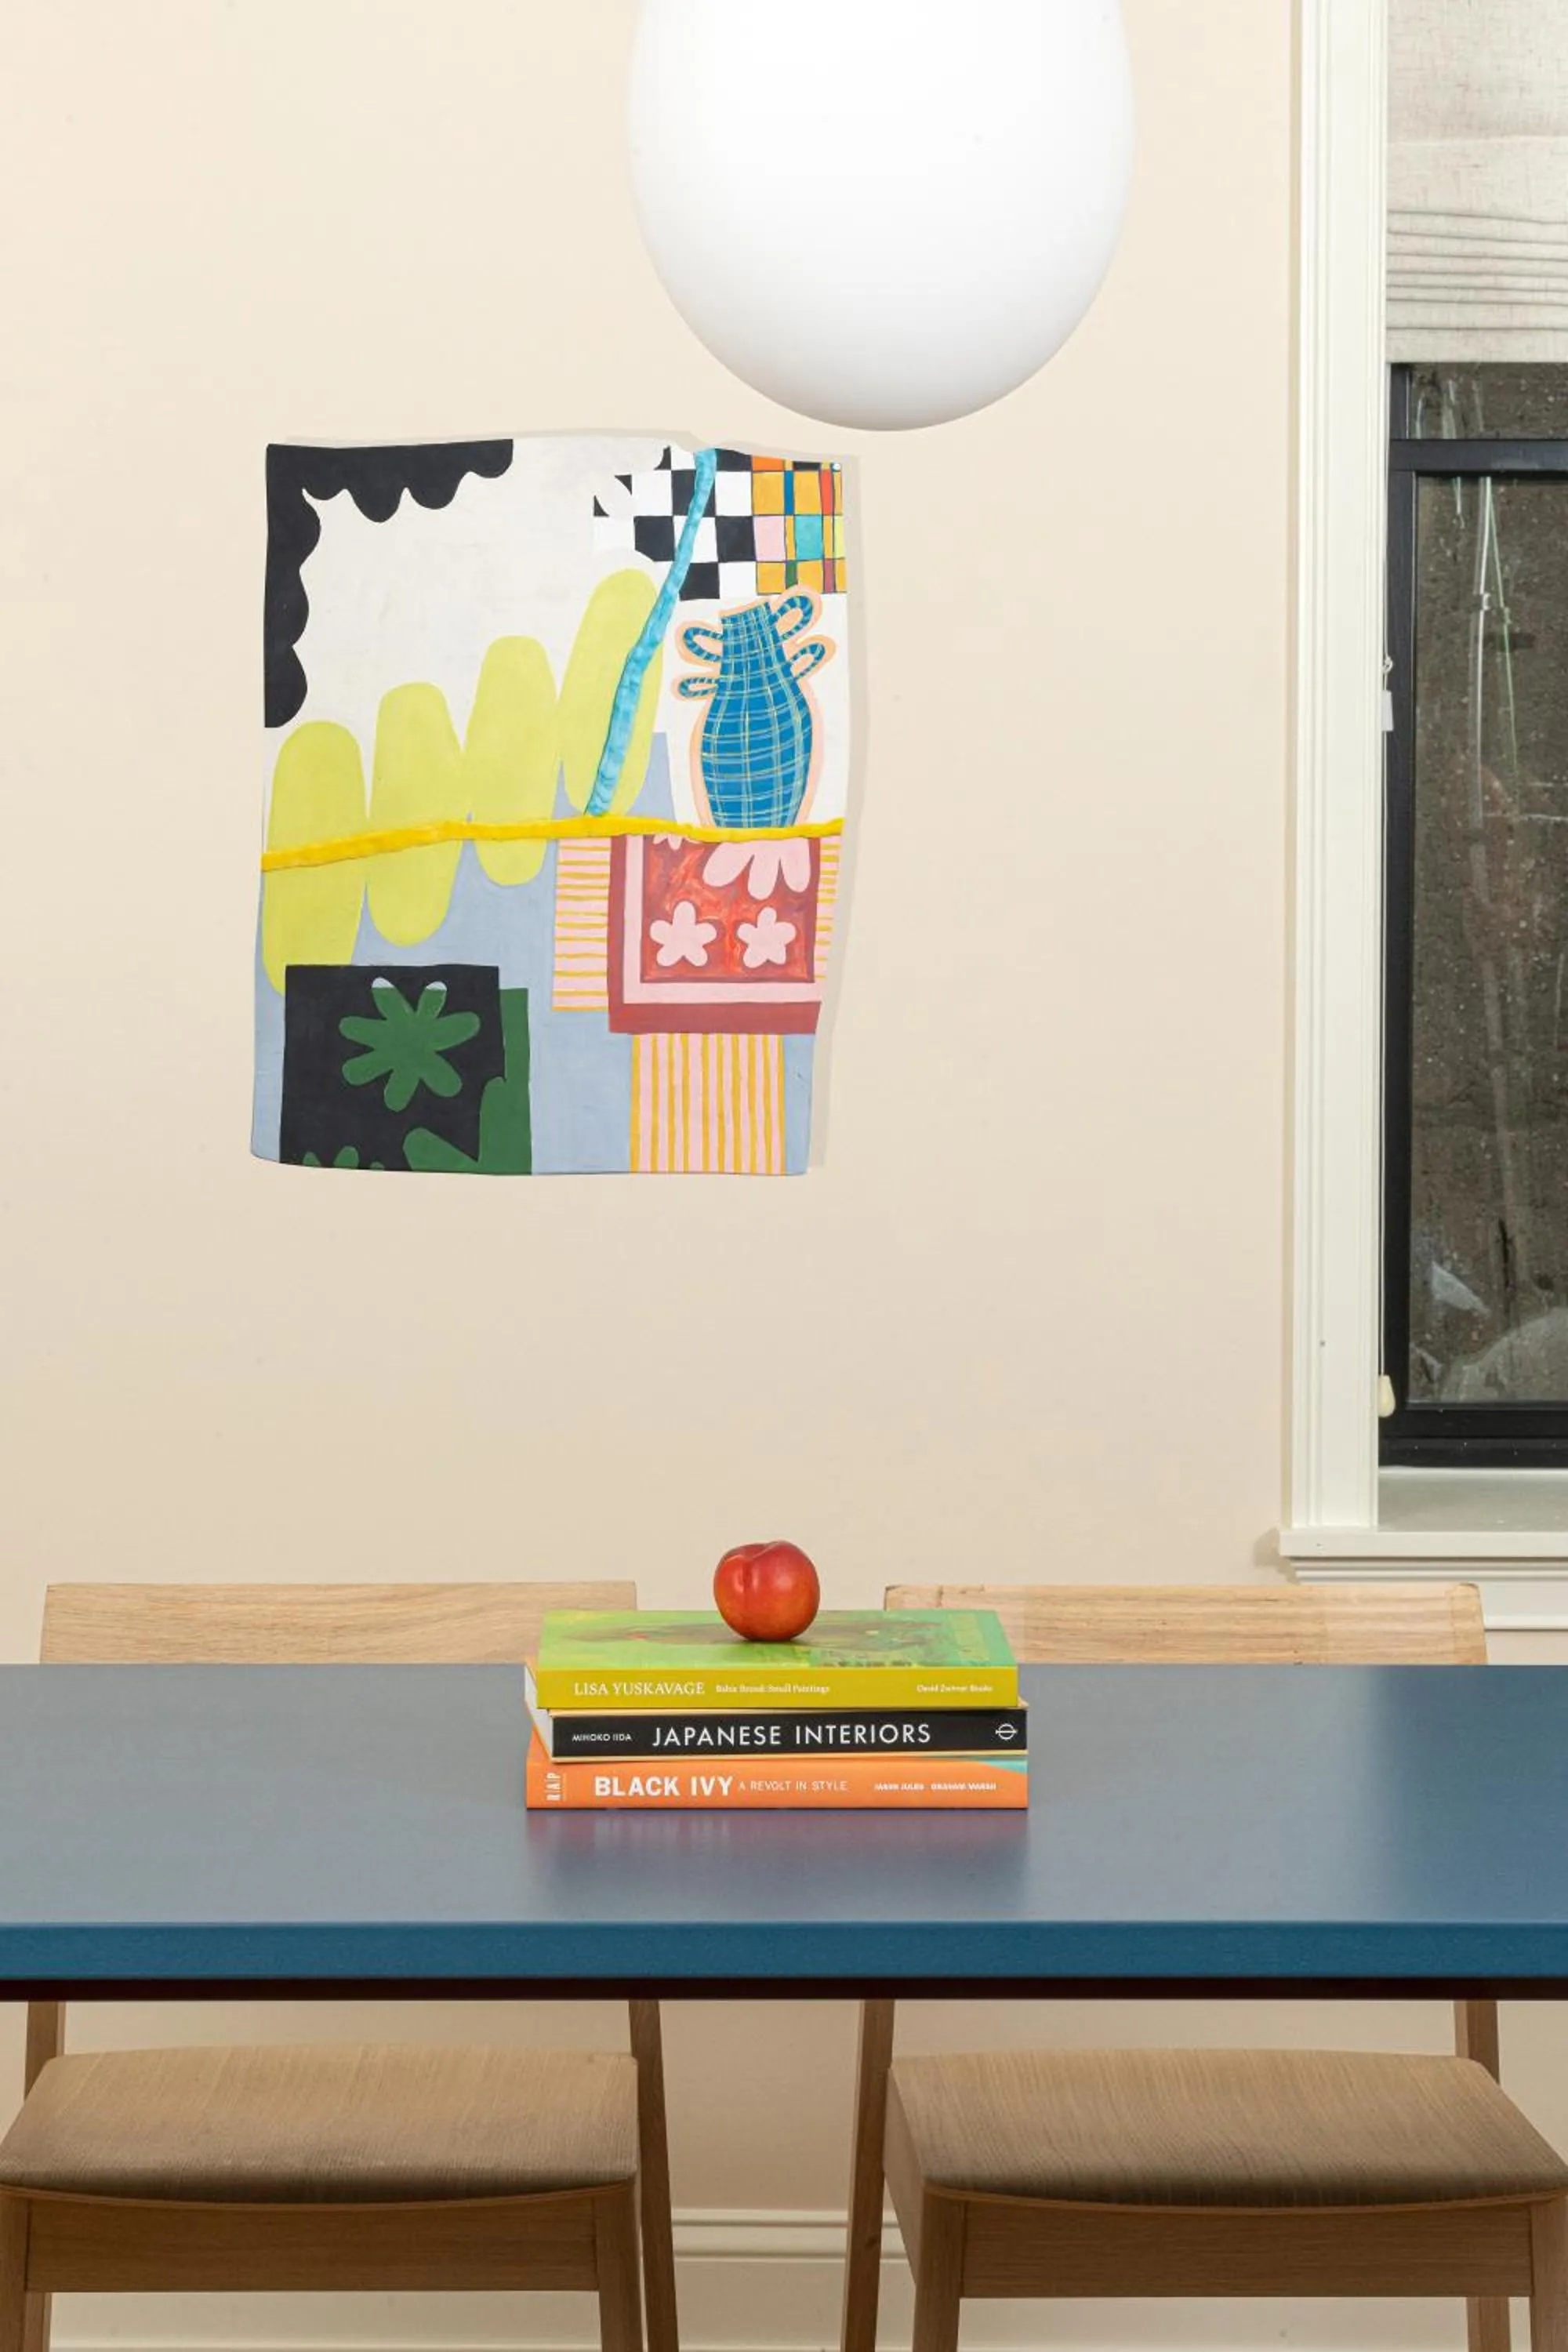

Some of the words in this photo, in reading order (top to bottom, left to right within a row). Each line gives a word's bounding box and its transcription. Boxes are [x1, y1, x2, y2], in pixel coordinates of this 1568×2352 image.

[573, 1682, 608, 1695] LISA
[612, 1682, 705, 1695] YUSKAVAGE
[572, 1733, 610, 1742] MIHOKO
[612, 1733, 633, 1742] IIDA
[652, 1725, 781, 1747] JAPANESE
[796, 1723, 931, 1744] INTERIORS
[594, 1776, 681, 1796] BLACK
[691, 1776, 734, 1796] IVY
[739, 1780, 746, 1791] A
[750, 1780, 791, 1791] REVOLT
[796, 1780, 807, 1791] IN
[811, 1780, 848, 1791] STYLE
